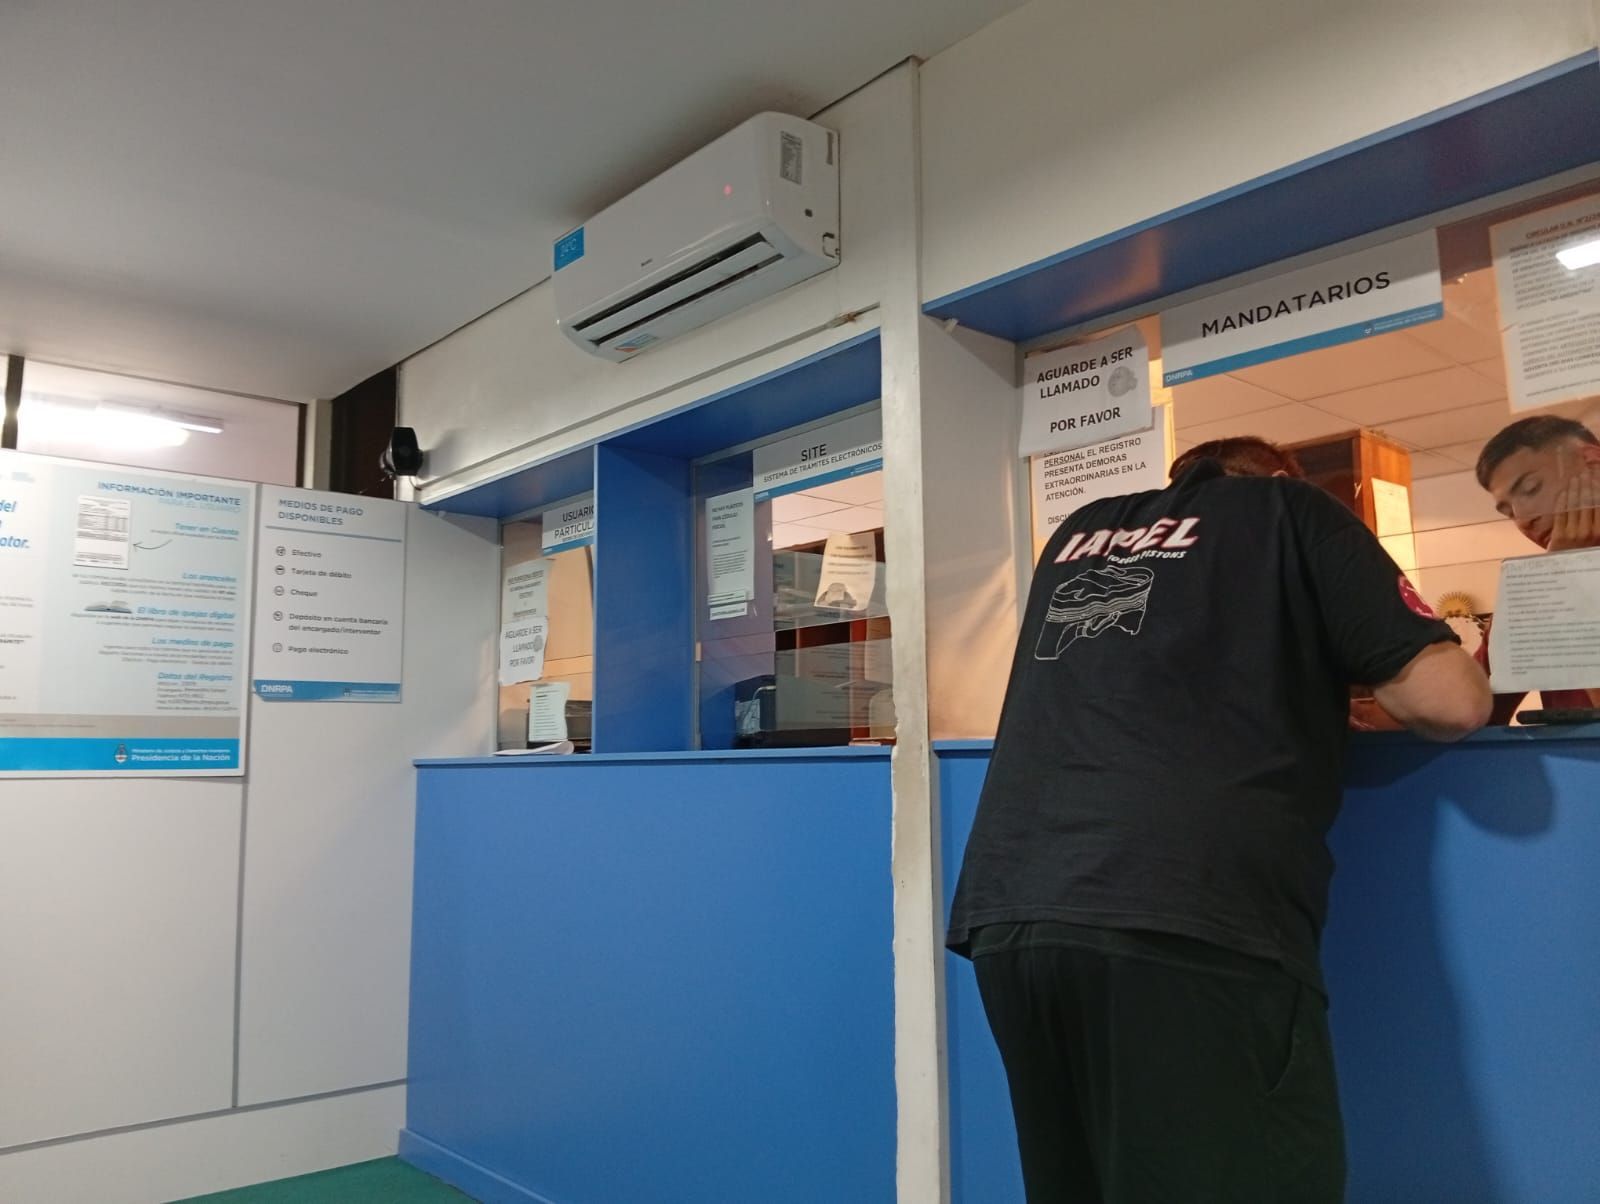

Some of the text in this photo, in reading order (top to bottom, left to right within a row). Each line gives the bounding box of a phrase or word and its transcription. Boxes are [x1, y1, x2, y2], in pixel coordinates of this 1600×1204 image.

[1202, 270, 1391, 338] MANDATARIOS
[1037, 346, 1133, 384] AGUARDE A SER
[1040, 375, 1101, 399] LLAMADO
[1050, 407, 1121, 433] POR FAVOR
[801, 443, 827, 462] SITE
[1044, 437, 1142, 467] PERSONAL EL REGISTRO
[1044, 453, 1127, 478] PRESENTA DEMORAS
[764, 470, 788, 483] SISTEMA
[789, 467, 798, 475] DE
[1044, 461, 1146, 490] EXTRAORDINARIAS EN LA
[98, 482, 240, 506] INFORMACIÓN IMPORTANTE
[1045, 487, 1086, 502] ATENCIÓN.
[279, 499, 364, 516] MEDIOS DE PAGO
[278, 511, 344, 525] DISPONIBLES
[1054, 517, 1200, 564] IAPEL
[292, 549, 322, 558] Efectivo
[292, 568, 317, 577] Tarjeta
[290, 588, 318, 597] Cheque
[149, 607, 166, 615] libro
[359, 617, 389, 626] bancaria
[288, 646, 307, 654] Pago
[158, 672, 182, 680] Datos
[260, 684, 293, 694] DNRPA
[131, 754, 179, 762] Presidencia
[202, 753, 231, 761] Nación
